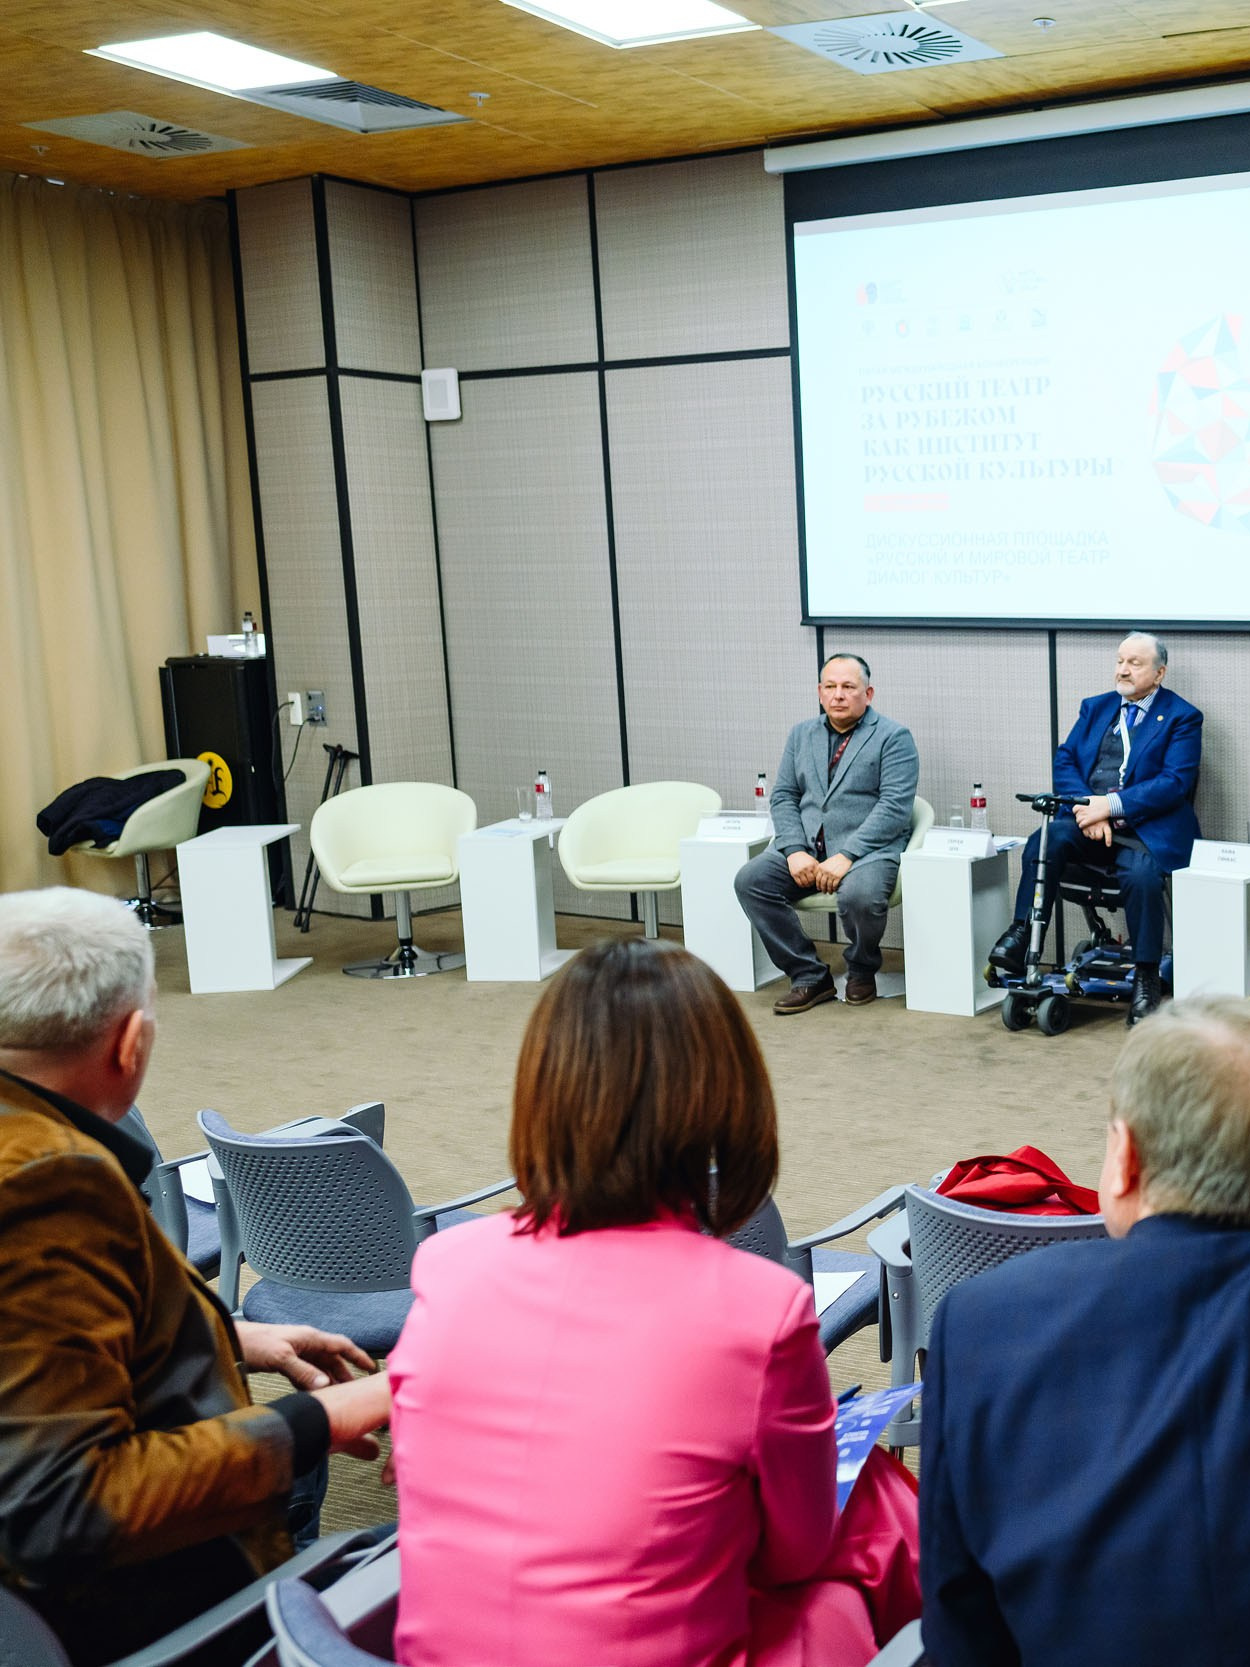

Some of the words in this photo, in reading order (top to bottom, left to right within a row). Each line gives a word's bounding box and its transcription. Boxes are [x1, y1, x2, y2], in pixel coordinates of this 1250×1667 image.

[861, 376, 970, 403] РУССКИЙ
[977, 376, 1051, 399] ТЕАТР
[861, 411, 888, 431] ЗА
[895, 405, 1017, 430] РУБЕЖОМ
[863, 437, 910, 457] КАК
[863, 457, 970, 483] РУССКОЙ
[979, 457, 1113, 480] КУЛЬТУРЫ
